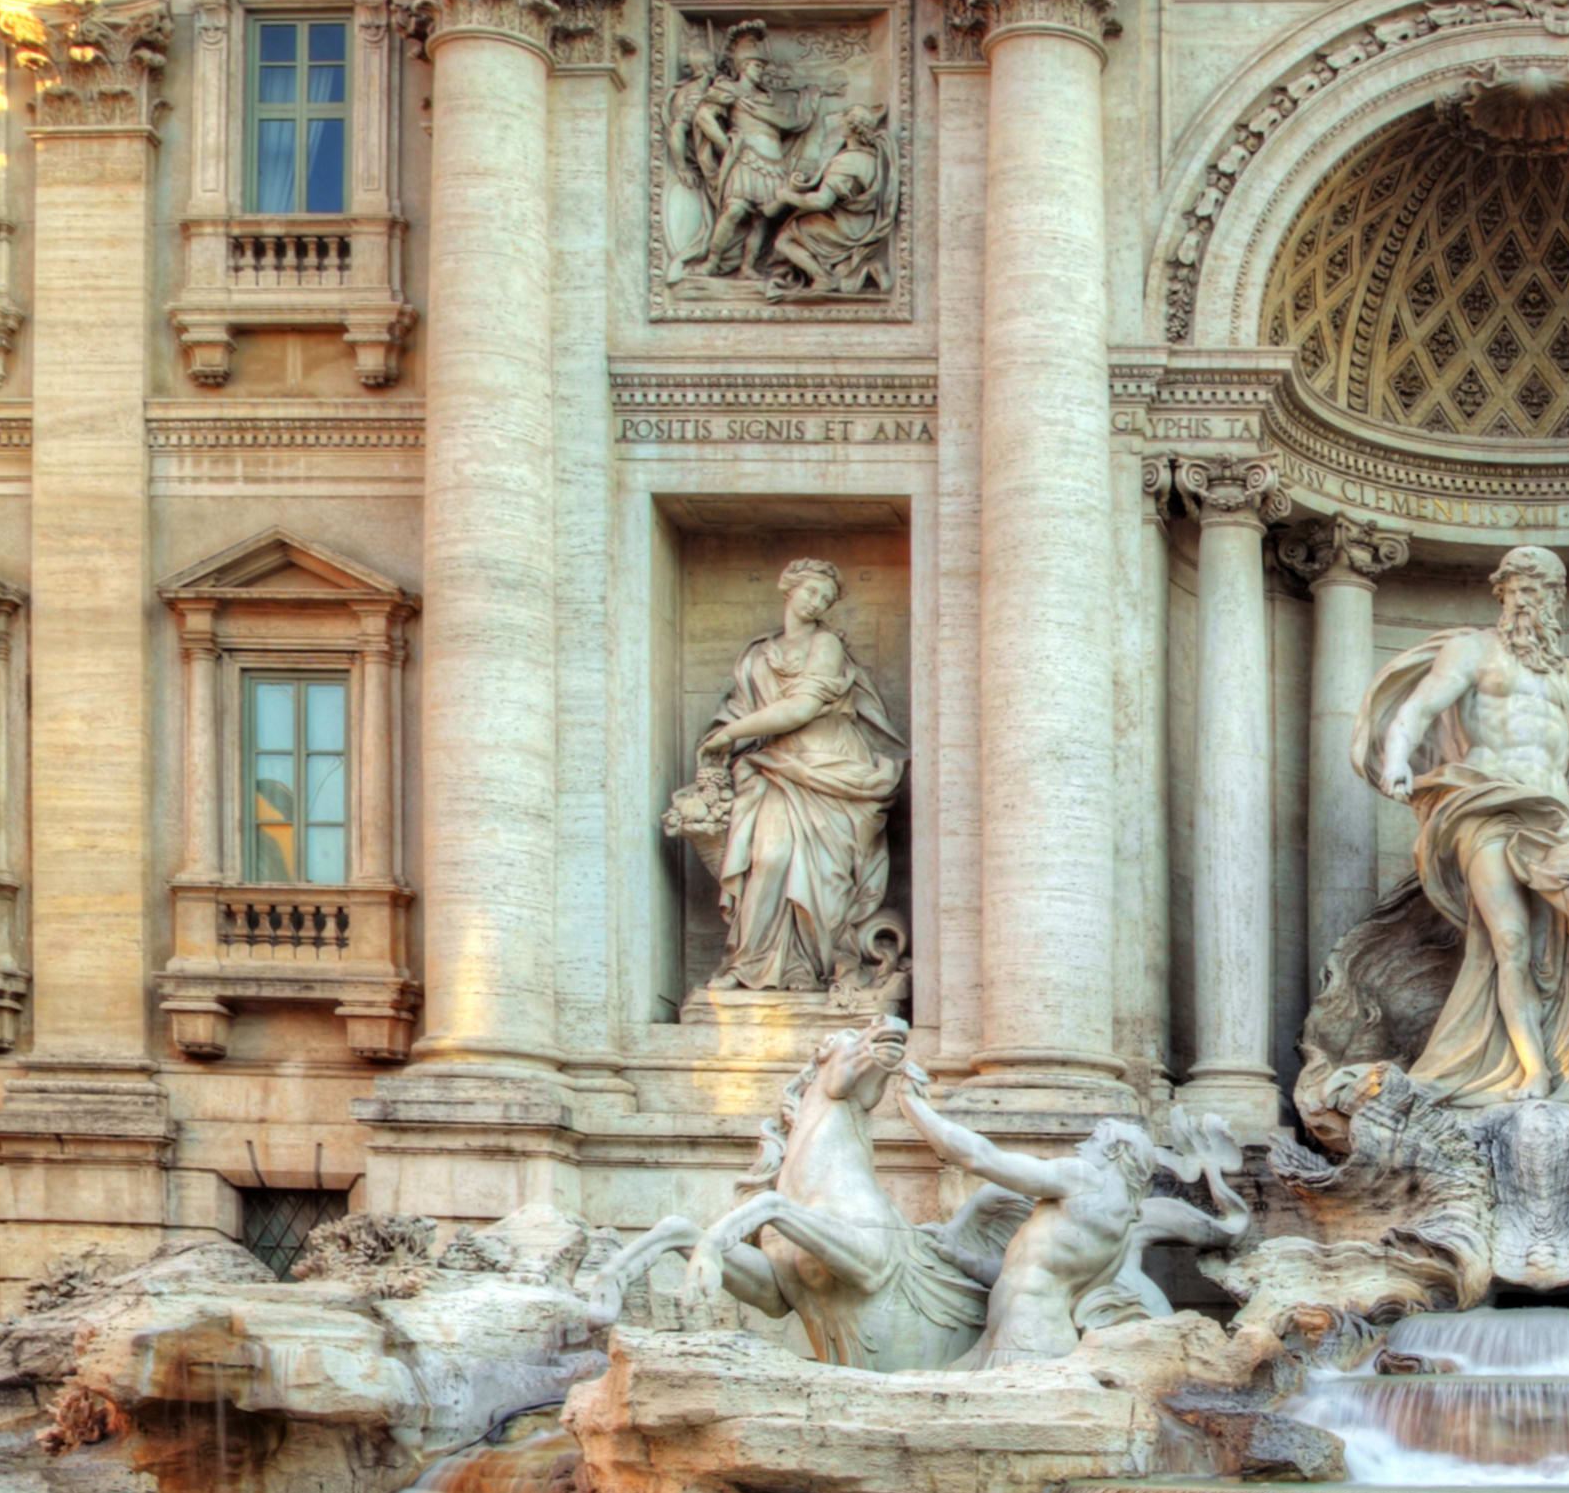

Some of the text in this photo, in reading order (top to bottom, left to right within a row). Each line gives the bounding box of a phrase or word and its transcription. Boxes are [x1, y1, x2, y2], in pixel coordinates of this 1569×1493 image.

[621, 418, 712, 441] POSITIS
[727, 418, 806, 441] SIGNIS
[823, 420, 854, 441] ET
[871, 420, 934, 441] ANA
